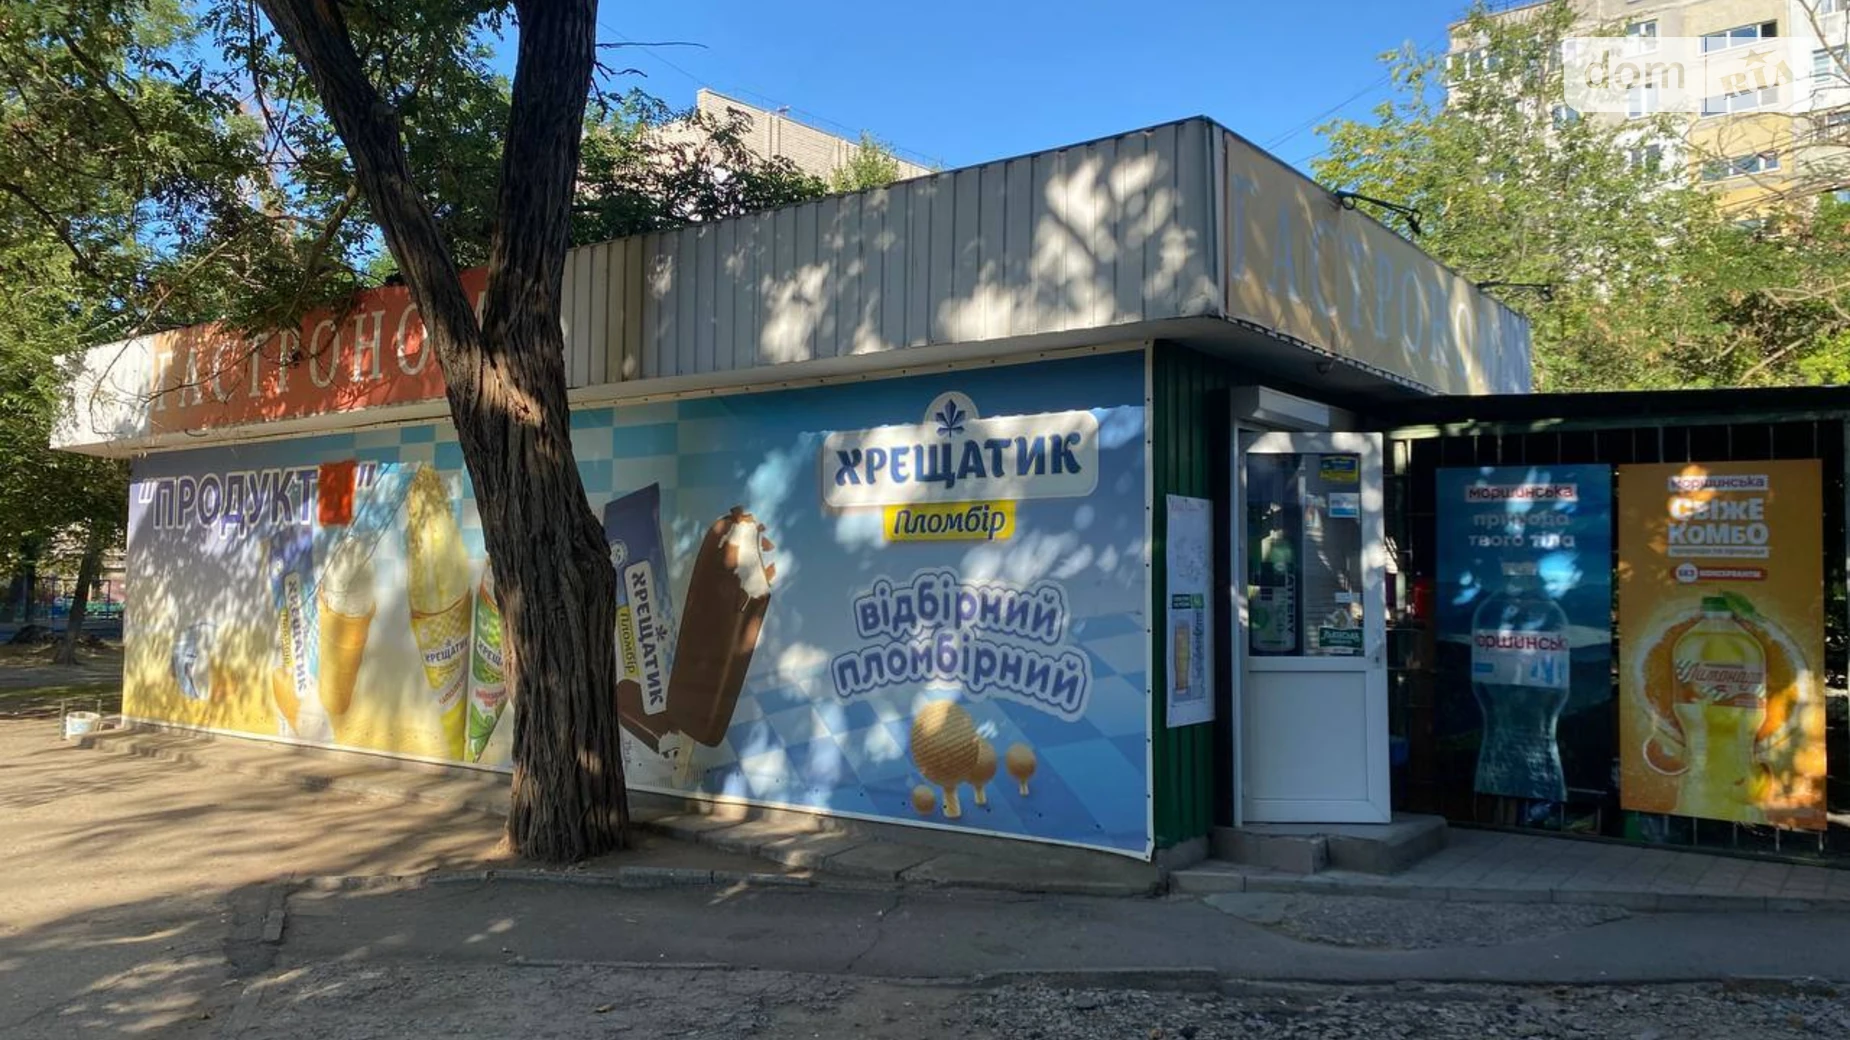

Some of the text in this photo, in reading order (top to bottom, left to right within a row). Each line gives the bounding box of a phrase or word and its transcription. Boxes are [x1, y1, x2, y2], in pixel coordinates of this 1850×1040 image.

[1232, 173, 1500, 386] ГАСТРОНО
[154, 301, 434, 411] ГАСТРОНО
[834, 431, 1082, 490] ХРЕЩАТИК
[138, 460, 378, 540] "ПРОДУКТ"
[893, 504, 1006, 540] Пломбір
[1468, 485, 1575, 501] моршинська
[1473, 512, 1571, 529] природа
[1669, 497, 1764, 520] СВІЖЕ
[1468, 533, 1524, 548] твого
[1667, 522, 1769, 545] КОМБО
[858, 578, 1060, 638] відбірний
[620, 610, 636, 675] Пломбір
[631, 570, 664, 706] ХРЕЩАТИК
[837, 632, 1080, 705] пломбірний
